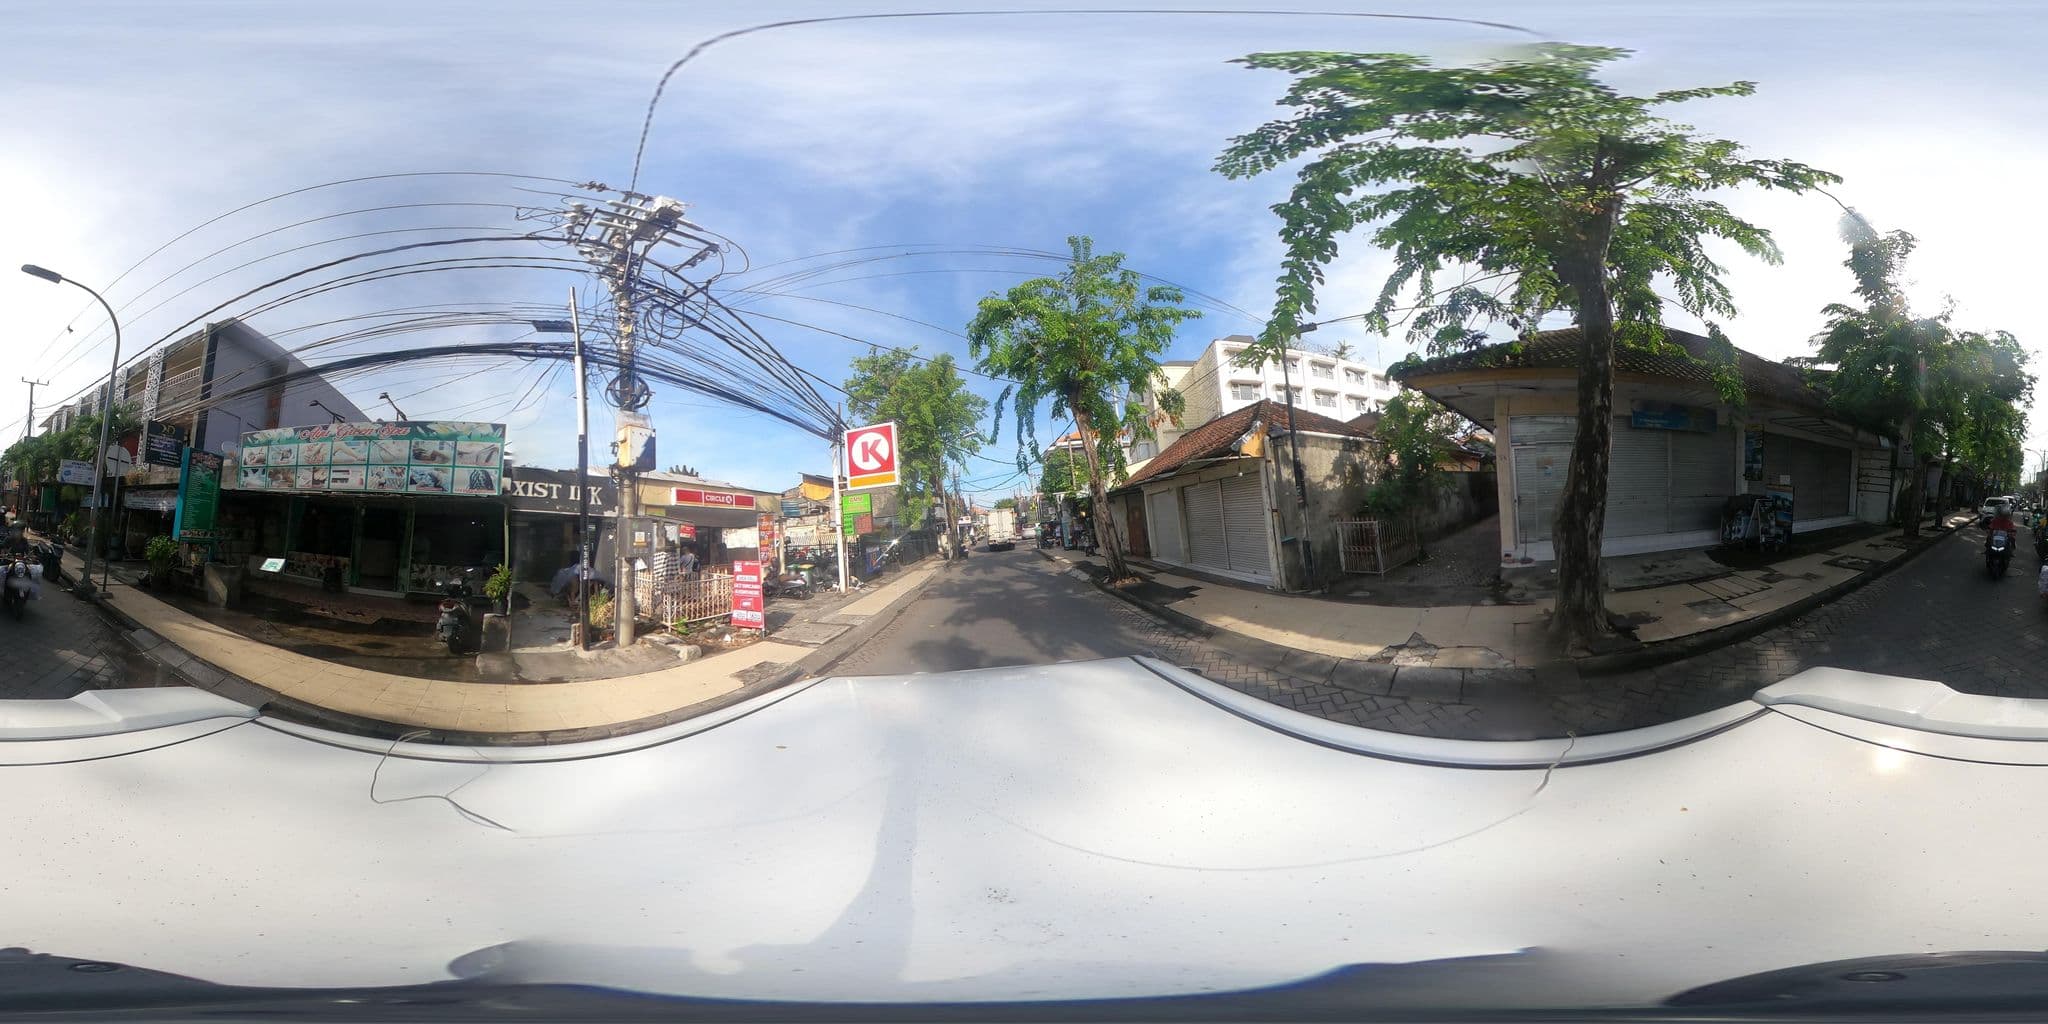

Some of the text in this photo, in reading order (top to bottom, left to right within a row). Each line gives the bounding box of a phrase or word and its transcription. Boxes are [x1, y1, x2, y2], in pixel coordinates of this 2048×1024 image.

[379, 422, 410, 439] Spa
[860, 438, 888, 467] K
[568, 485, 603, 505] IK
[705, 494, 725, 503] CIRCLE
